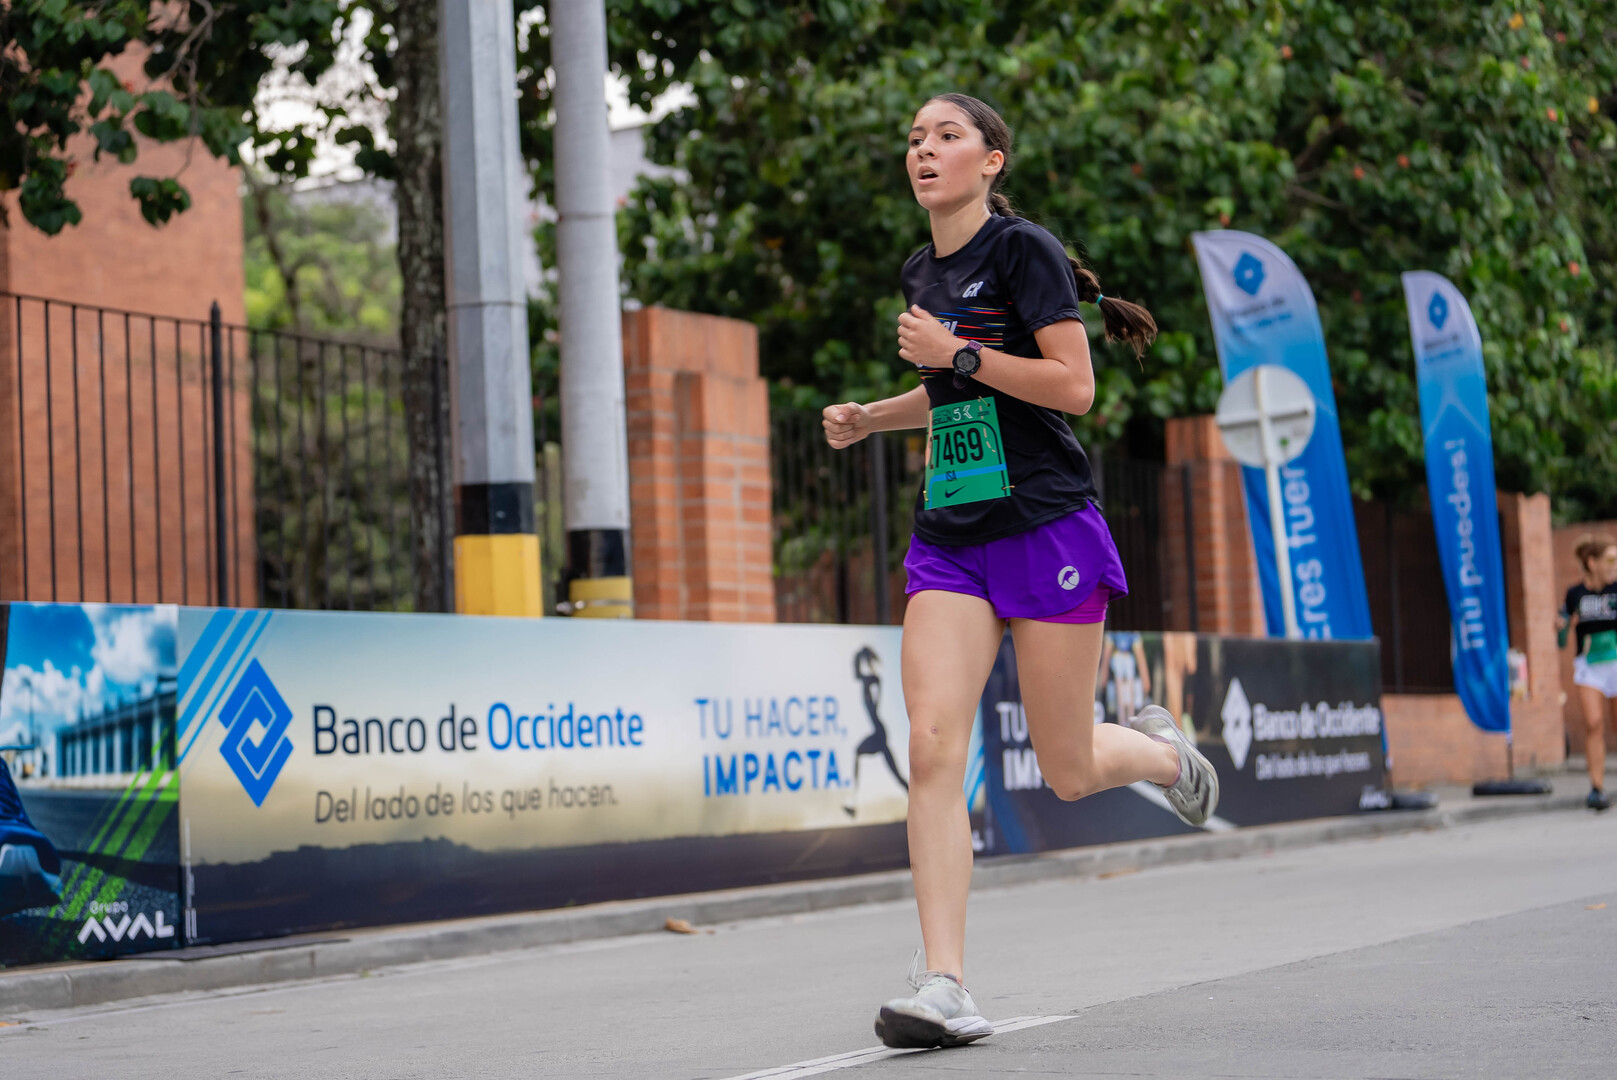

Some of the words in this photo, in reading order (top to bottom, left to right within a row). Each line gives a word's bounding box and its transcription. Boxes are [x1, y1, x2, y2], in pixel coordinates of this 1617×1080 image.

[313, 704, 427, 755] Banco
[438, 703, 479, 752] de
[488, 702, 644, 750] Occidente
[694, 698, 732, 740] TU
[1253, 702, 1298, 741] Banco
[1299, 702, 1316, 739] de
[1316, 700, 1381, 738] Occidente
[703, 750, 851, 797] IMPACTA.
[315, 787, 356, 823] Del
[364, 785, 420, 820] lado
[425, 783, 454, 816] de
[462, 782, 494, 813] los
[501, 786, 542, 820] que
[548, 777, 619, 808] hacen.
[77, 910, 175, 945] AVAL
[89, 900, 128, 915] Grupo
